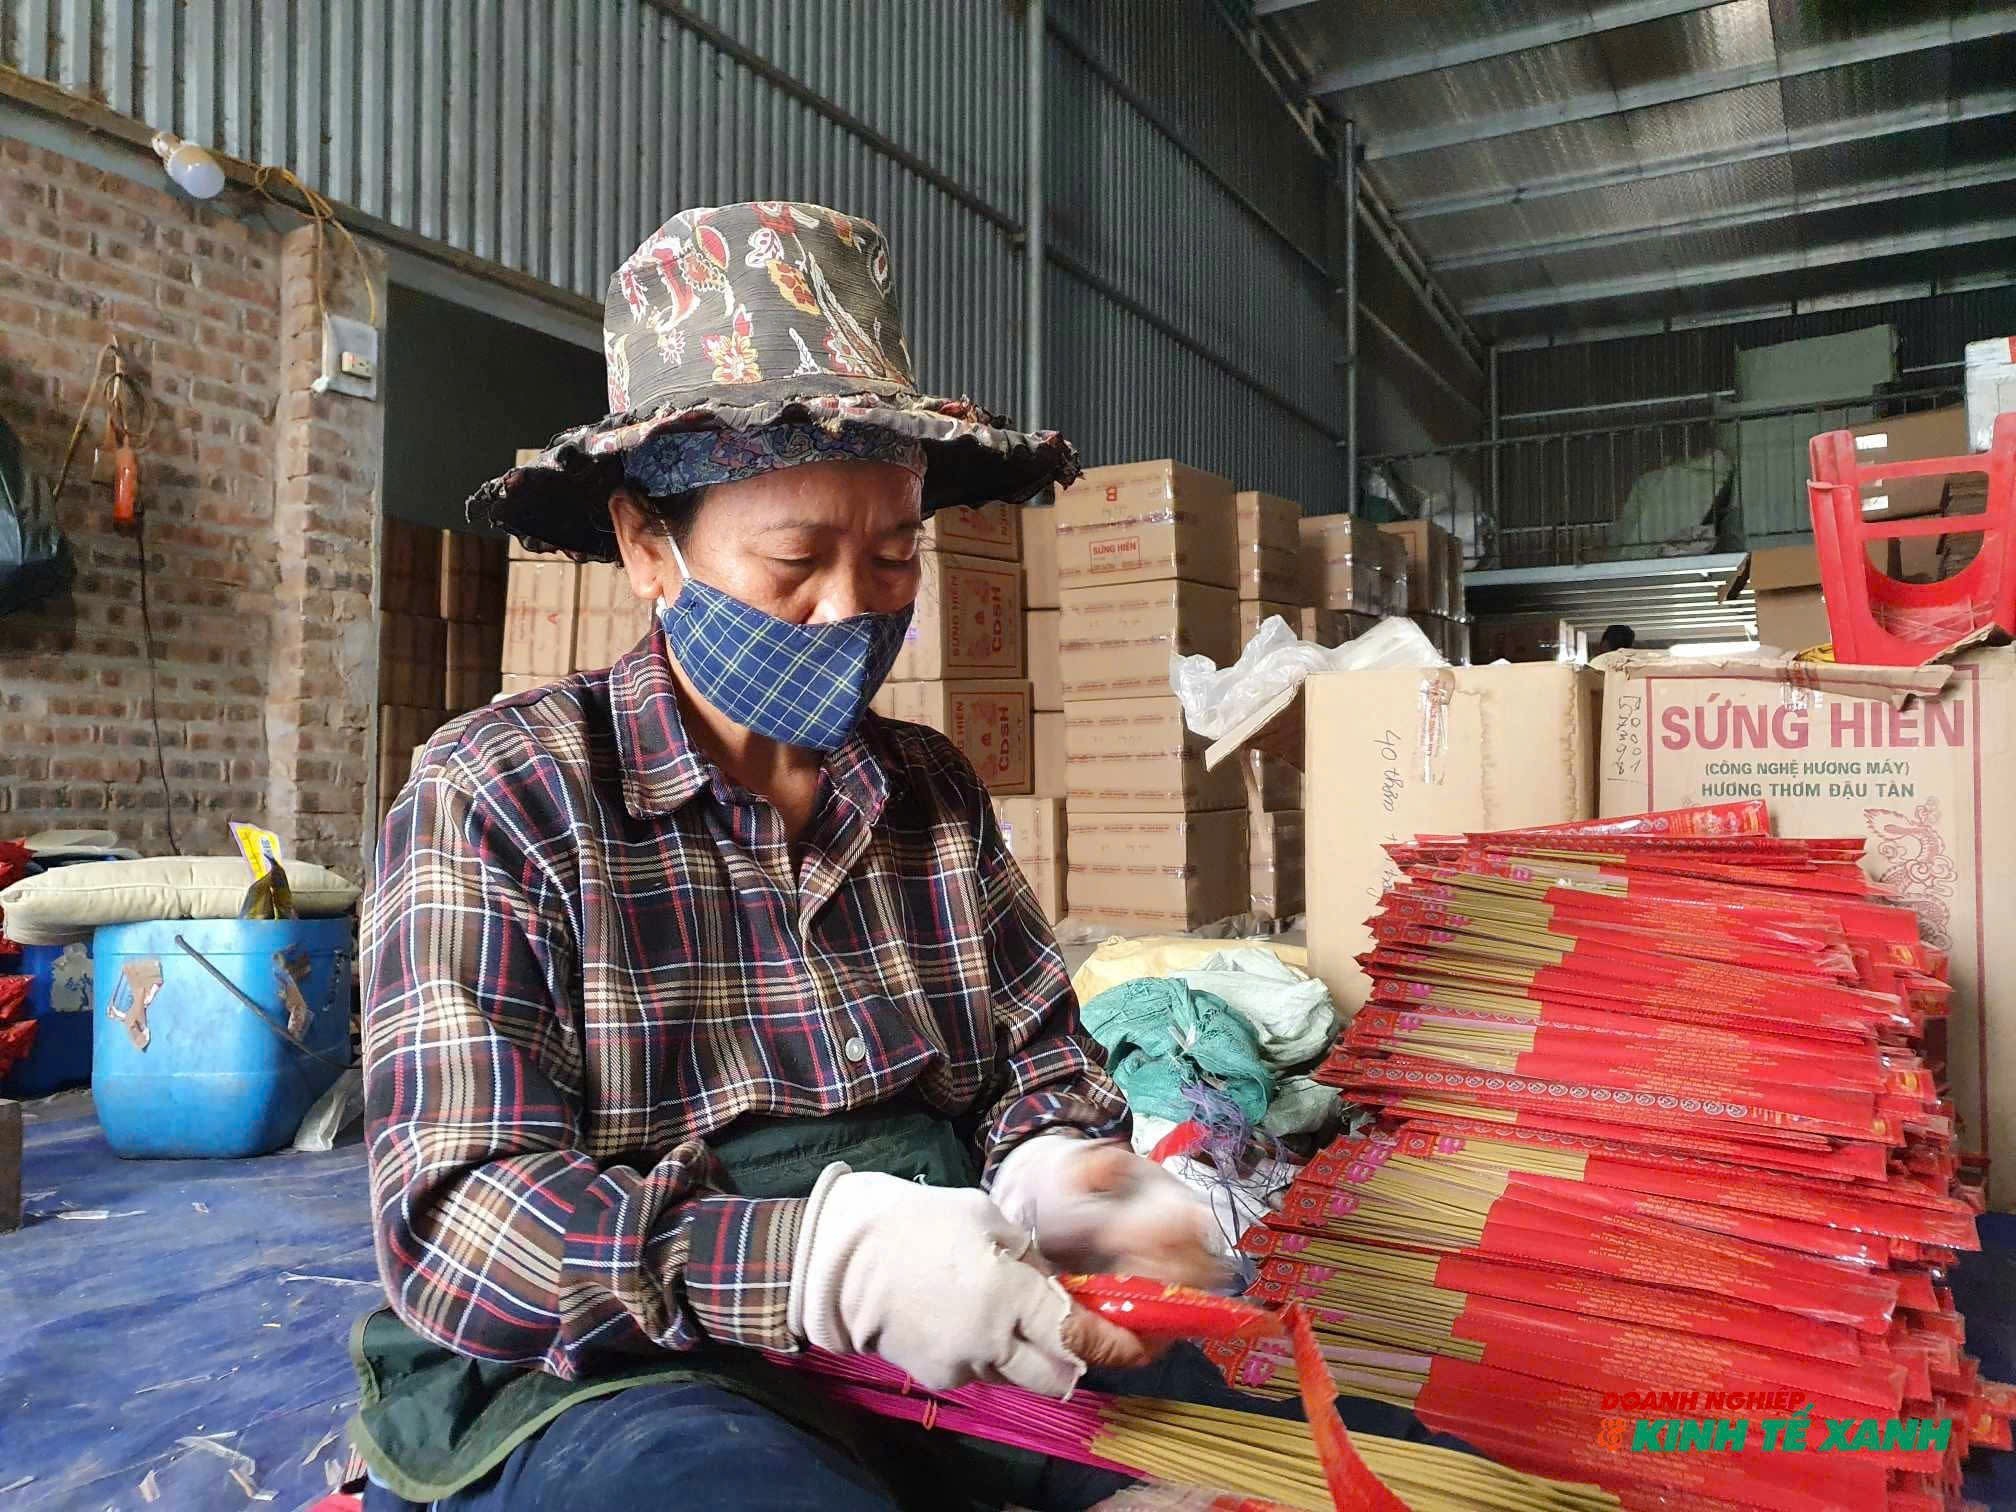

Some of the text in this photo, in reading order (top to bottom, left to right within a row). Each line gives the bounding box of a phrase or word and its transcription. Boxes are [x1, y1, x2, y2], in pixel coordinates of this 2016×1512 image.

[999, 706, 1008, 772] CDSH
[1661, 692, 1809, 751] SỨNG
[1757, 759, 1799, 778] NGHỆ
[1803, 760, 1862, 776] HƯƠNG
[1866, 758, 1911, 777] MÁY)
[1701, 781, 1763, 798] HƯƠNG
[1769, 781, 1821, 798] THƠM
